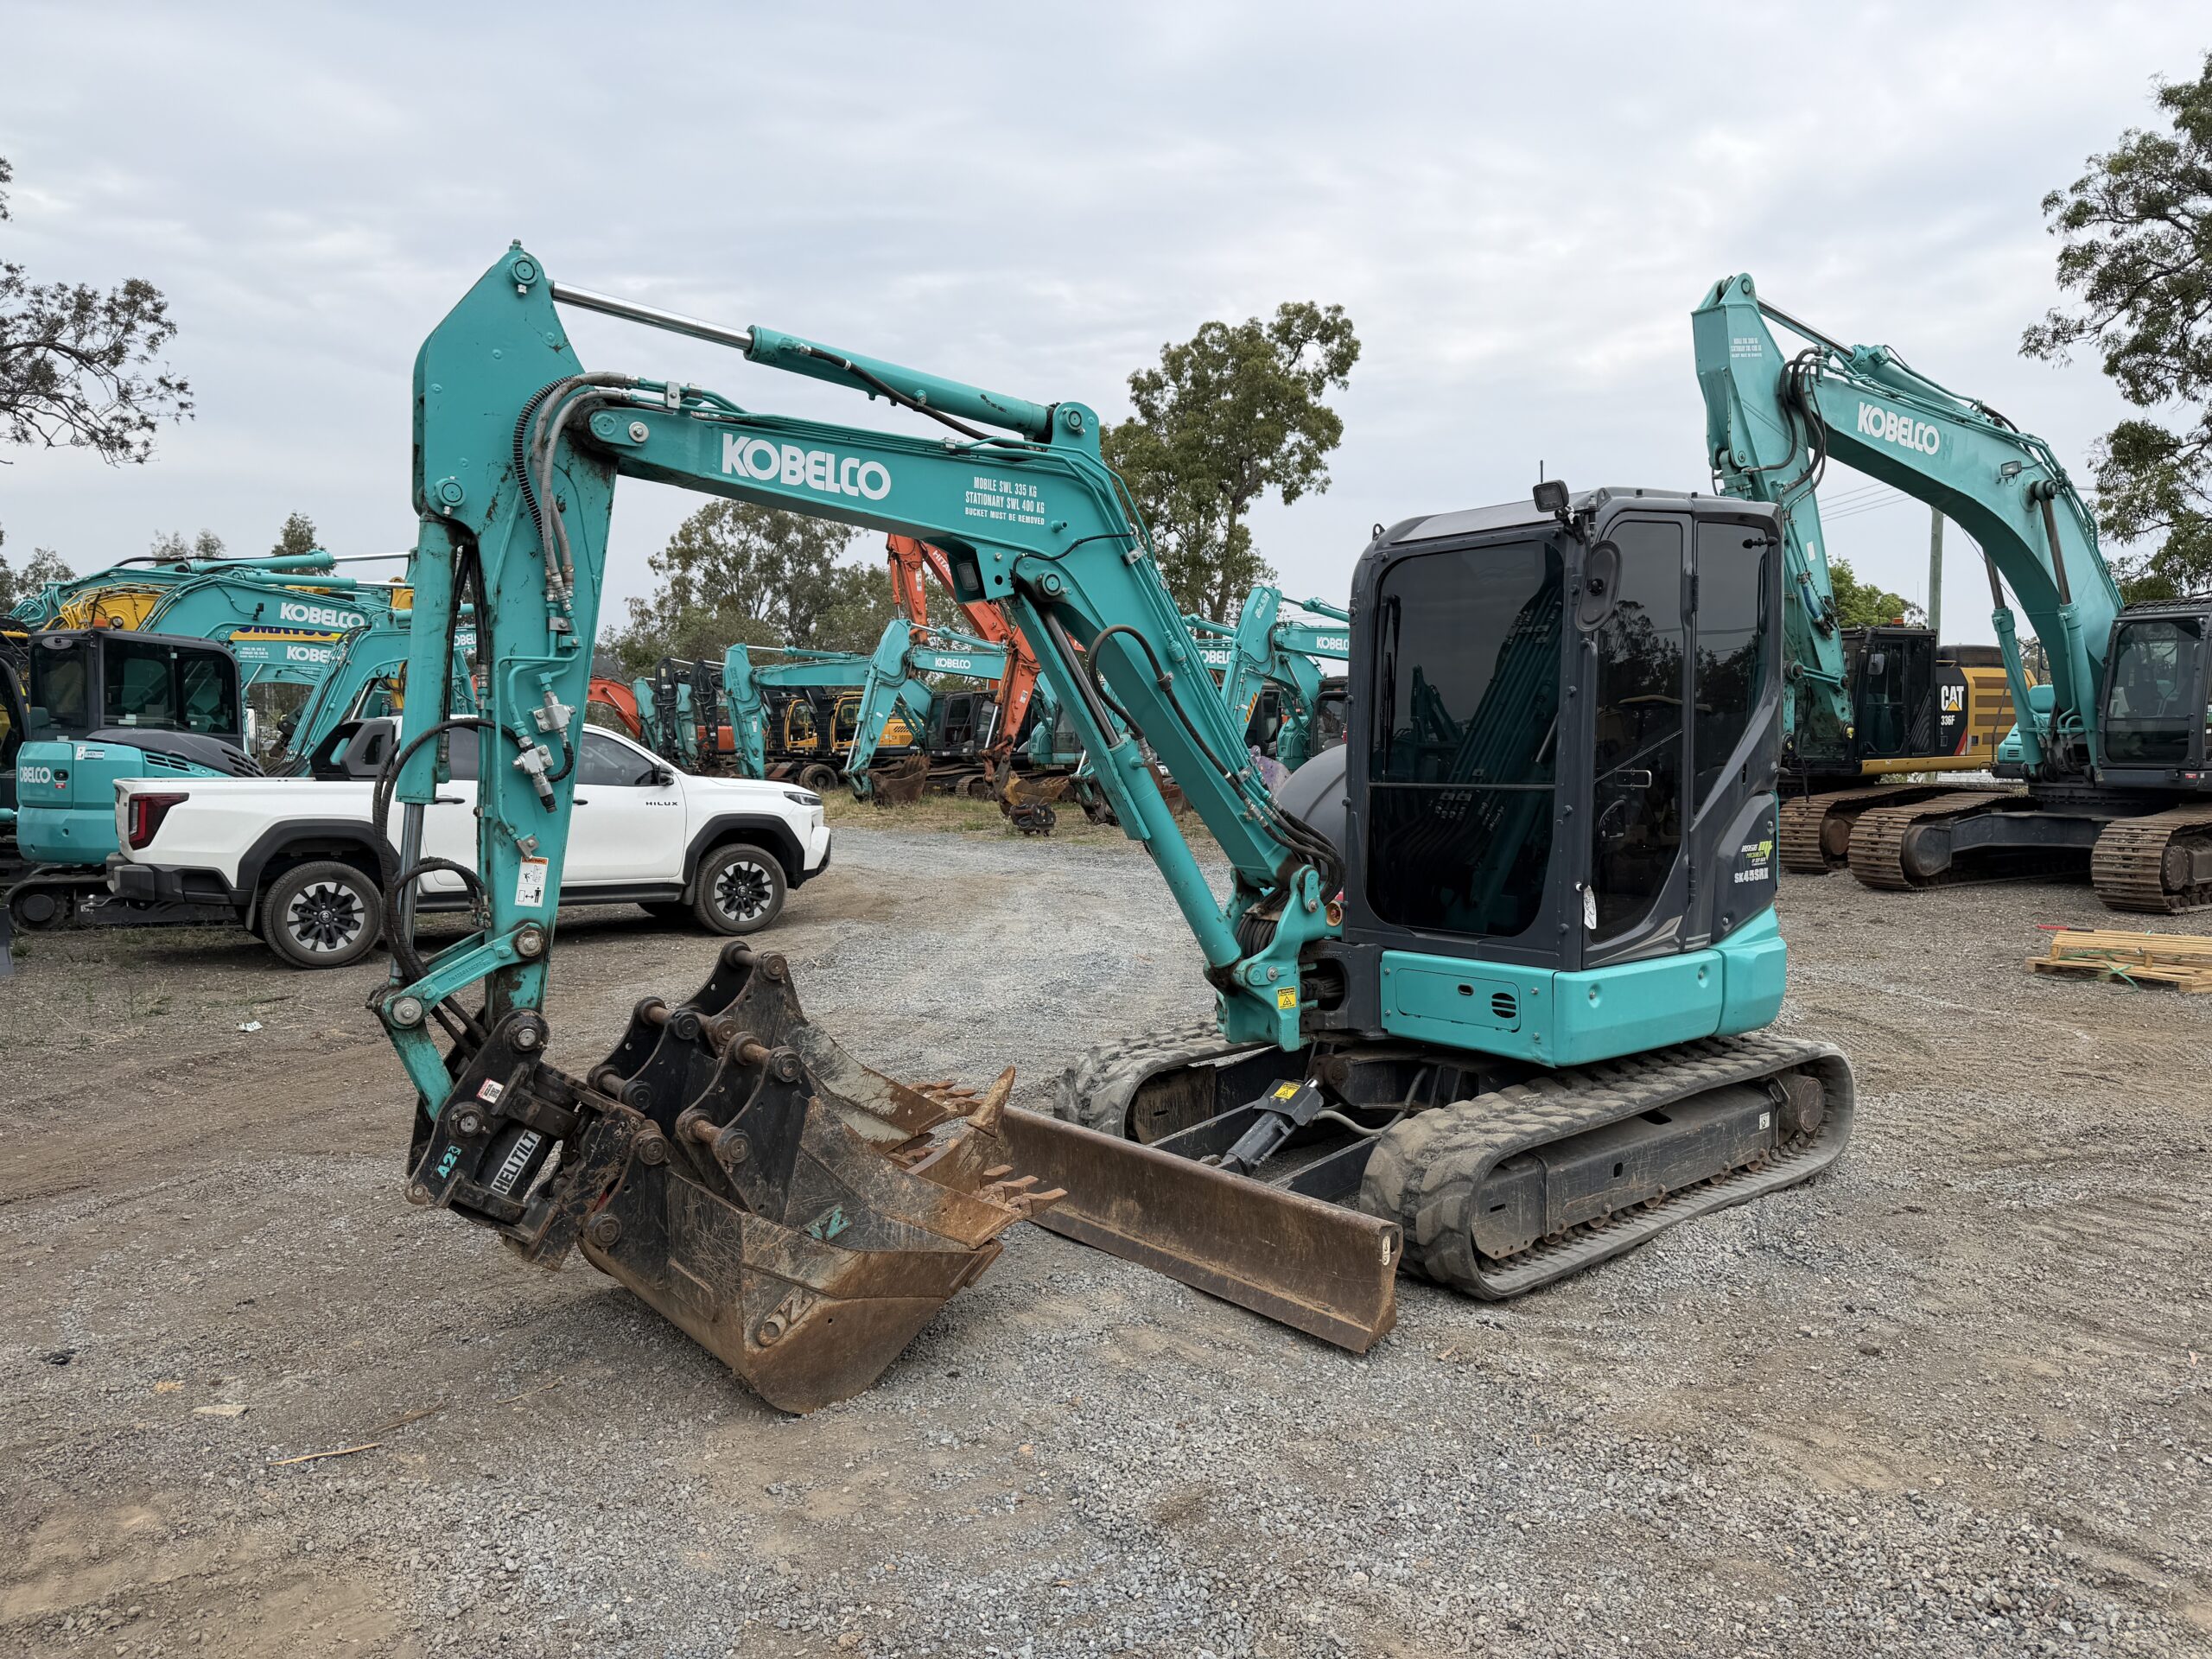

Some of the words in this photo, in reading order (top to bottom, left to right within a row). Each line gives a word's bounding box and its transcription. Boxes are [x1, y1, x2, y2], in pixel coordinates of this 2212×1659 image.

[1857, 401, 1941, 456] KOBELCO
[721, 432, 892, 501] KOBELCO
[974, 476, 997, 492] MOBILE
[999, 480, 1013, 494] SWL
[1014, 483, 1027, 497] 335
[1028, 485, 1038, 499] KG
[965, 491, 1005, 509] STATIONARY
[1007, 497, 1020, 511] SWL
[1022, 499, 1034, 513] 400
[1037, 501, 1046, 515] KG
[965, 507, 988, 518] BUCKET
[989, 510, 1007, 521] MUST
[1008, 513, 1016, 522] BE
[1018, 514, 1045, 526] REMOVED
[279, 602, 365, 629] KOBELCO
[934, 657, 971, 670] KOBELCO
[1941, 684, 1965, 712] CAT
[1940, 715, 1955, 726] 336F
